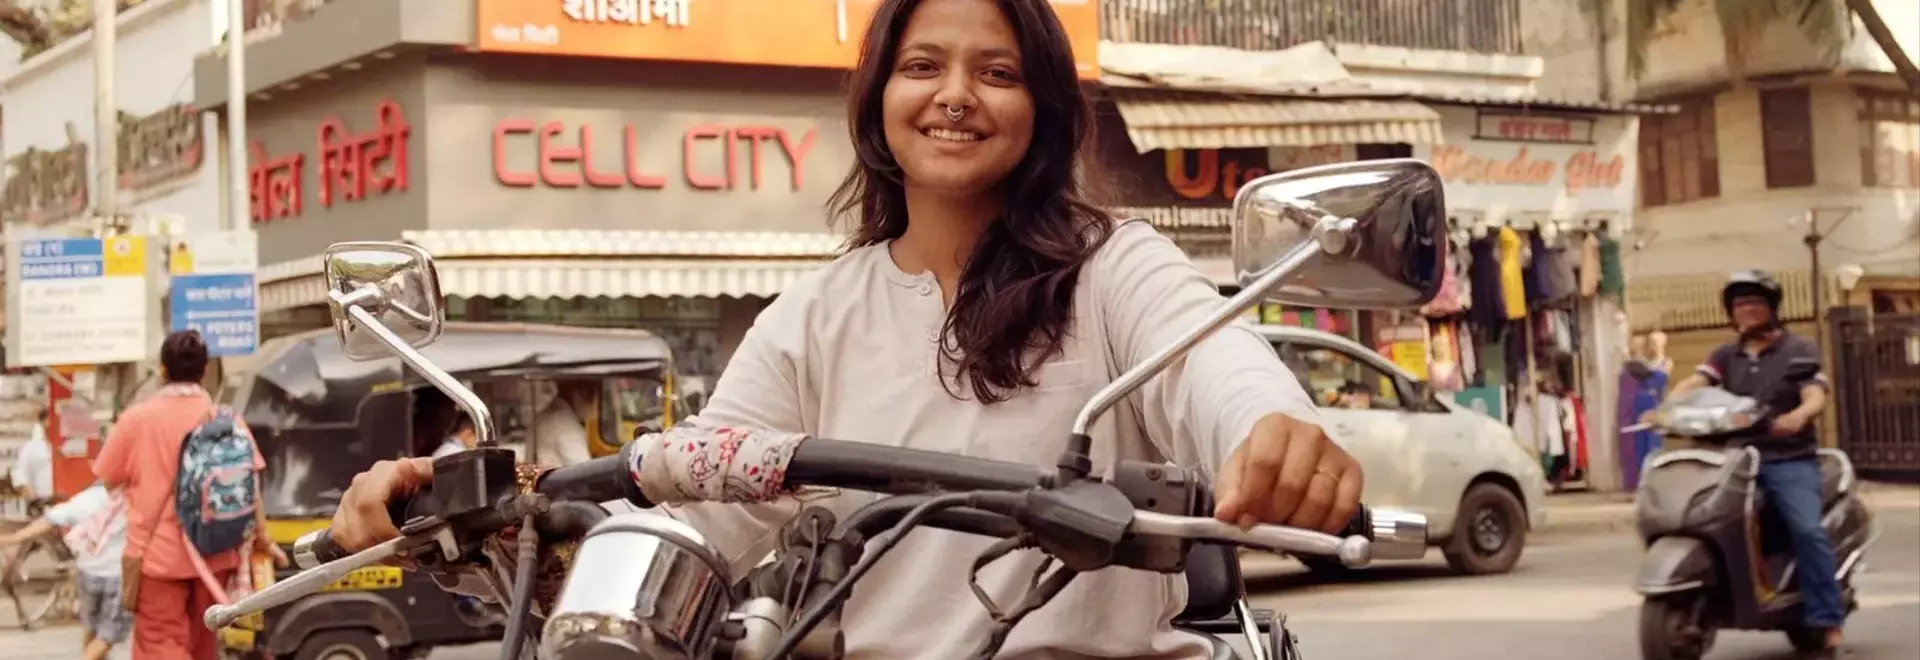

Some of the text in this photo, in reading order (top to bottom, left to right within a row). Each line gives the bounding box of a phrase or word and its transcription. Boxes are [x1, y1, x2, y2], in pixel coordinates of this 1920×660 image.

[317, 96, 412, 208] सिटी
[493, 119, 818, 190] CELL CITY
